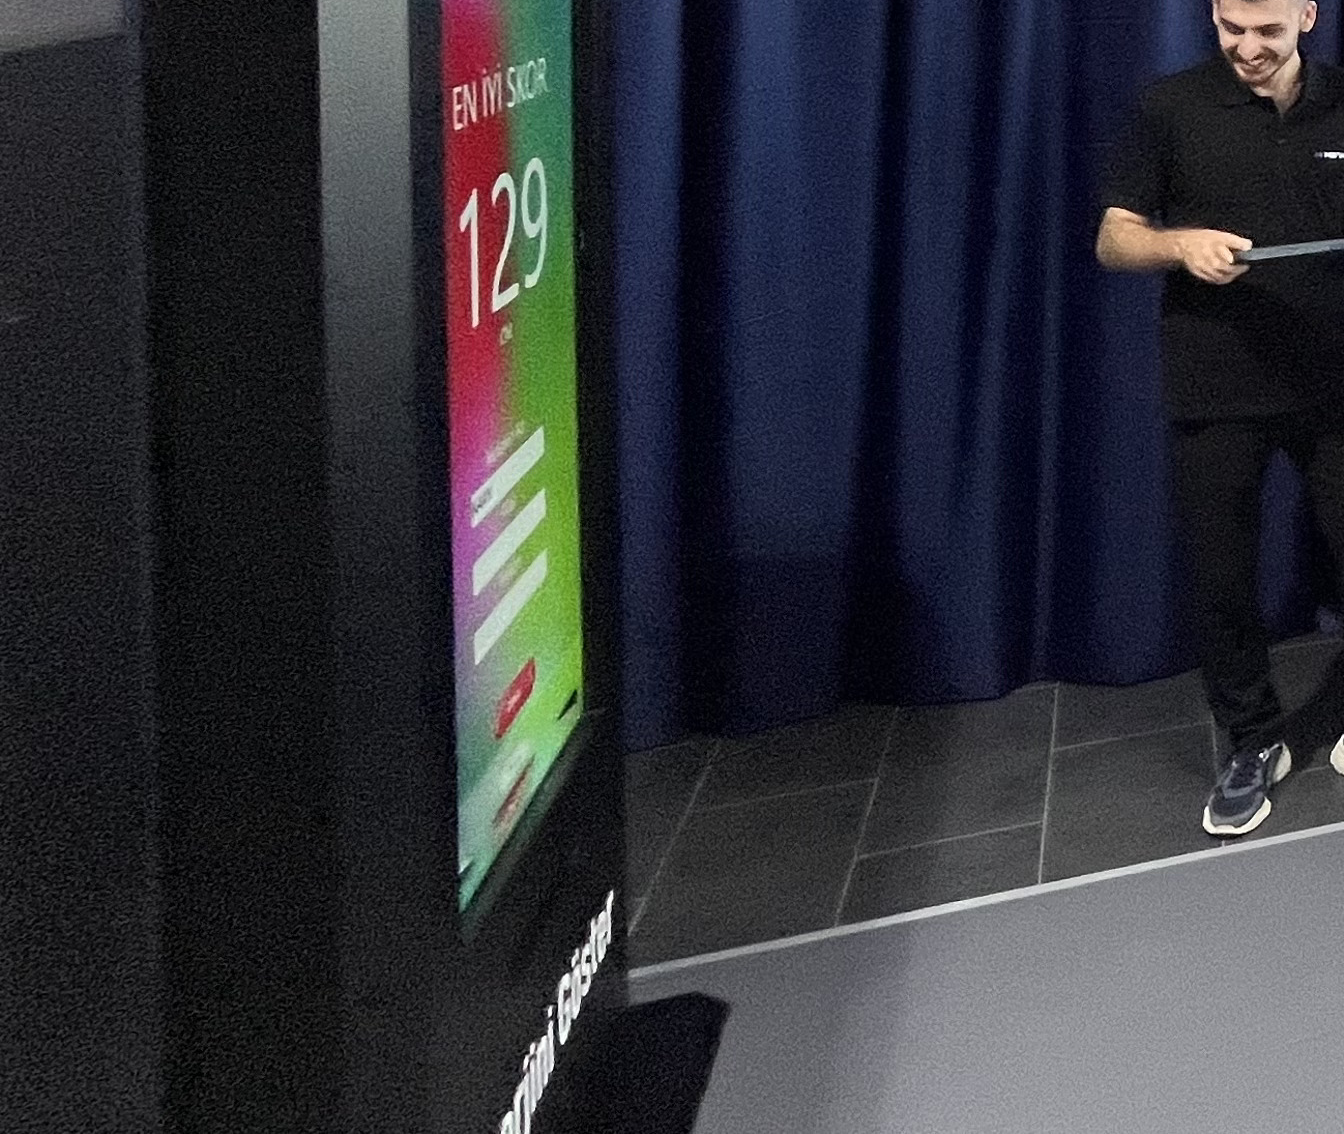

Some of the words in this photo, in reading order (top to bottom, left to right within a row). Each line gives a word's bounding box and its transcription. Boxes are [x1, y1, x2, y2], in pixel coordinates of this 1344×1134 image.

[453, 83, 478, 131] EN
[506, 57, 550, 109] SKOR
[459, 157, 548, 328] 129
